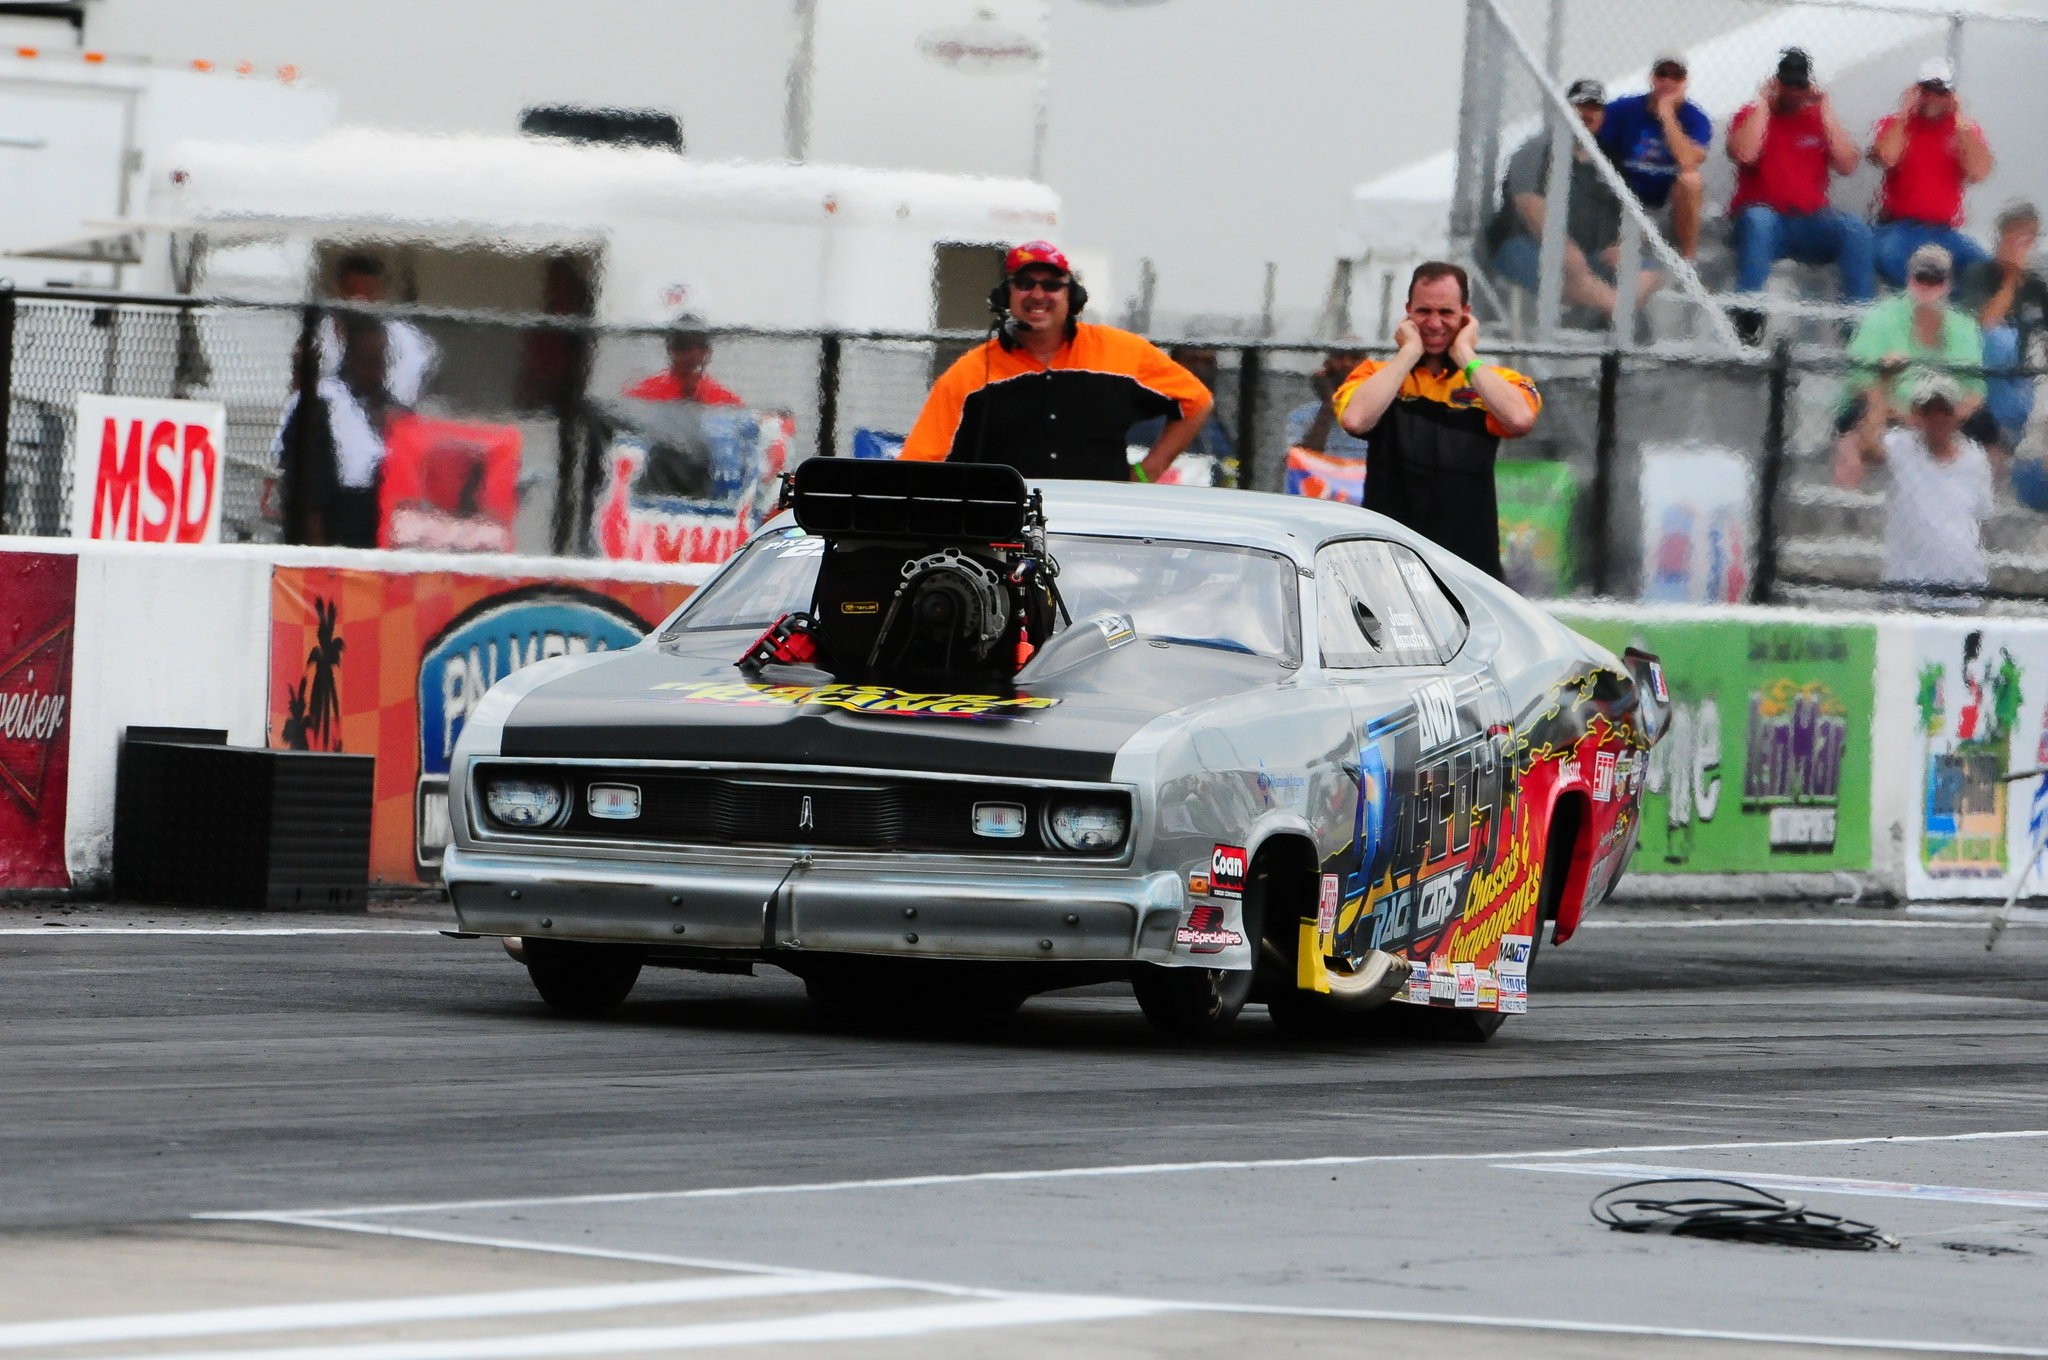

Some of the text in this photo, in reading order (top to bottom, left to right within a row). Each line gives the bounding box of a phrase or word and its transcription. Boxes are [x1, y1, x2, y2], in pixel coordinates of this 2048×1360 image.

[91, 418, 216, 543] MSD
[686, 688, 1000, 714] RACING
[1410, 678, 1461, 752] ANDY
[1213, 849, 1243, 877] Coan
[1463, 841, 1521, 924] Chassis
[1370, 891, 1412, 950] RACE
[1416, 862, 1467, 930] CARS
[1447, 862, 1541, 972] Components
